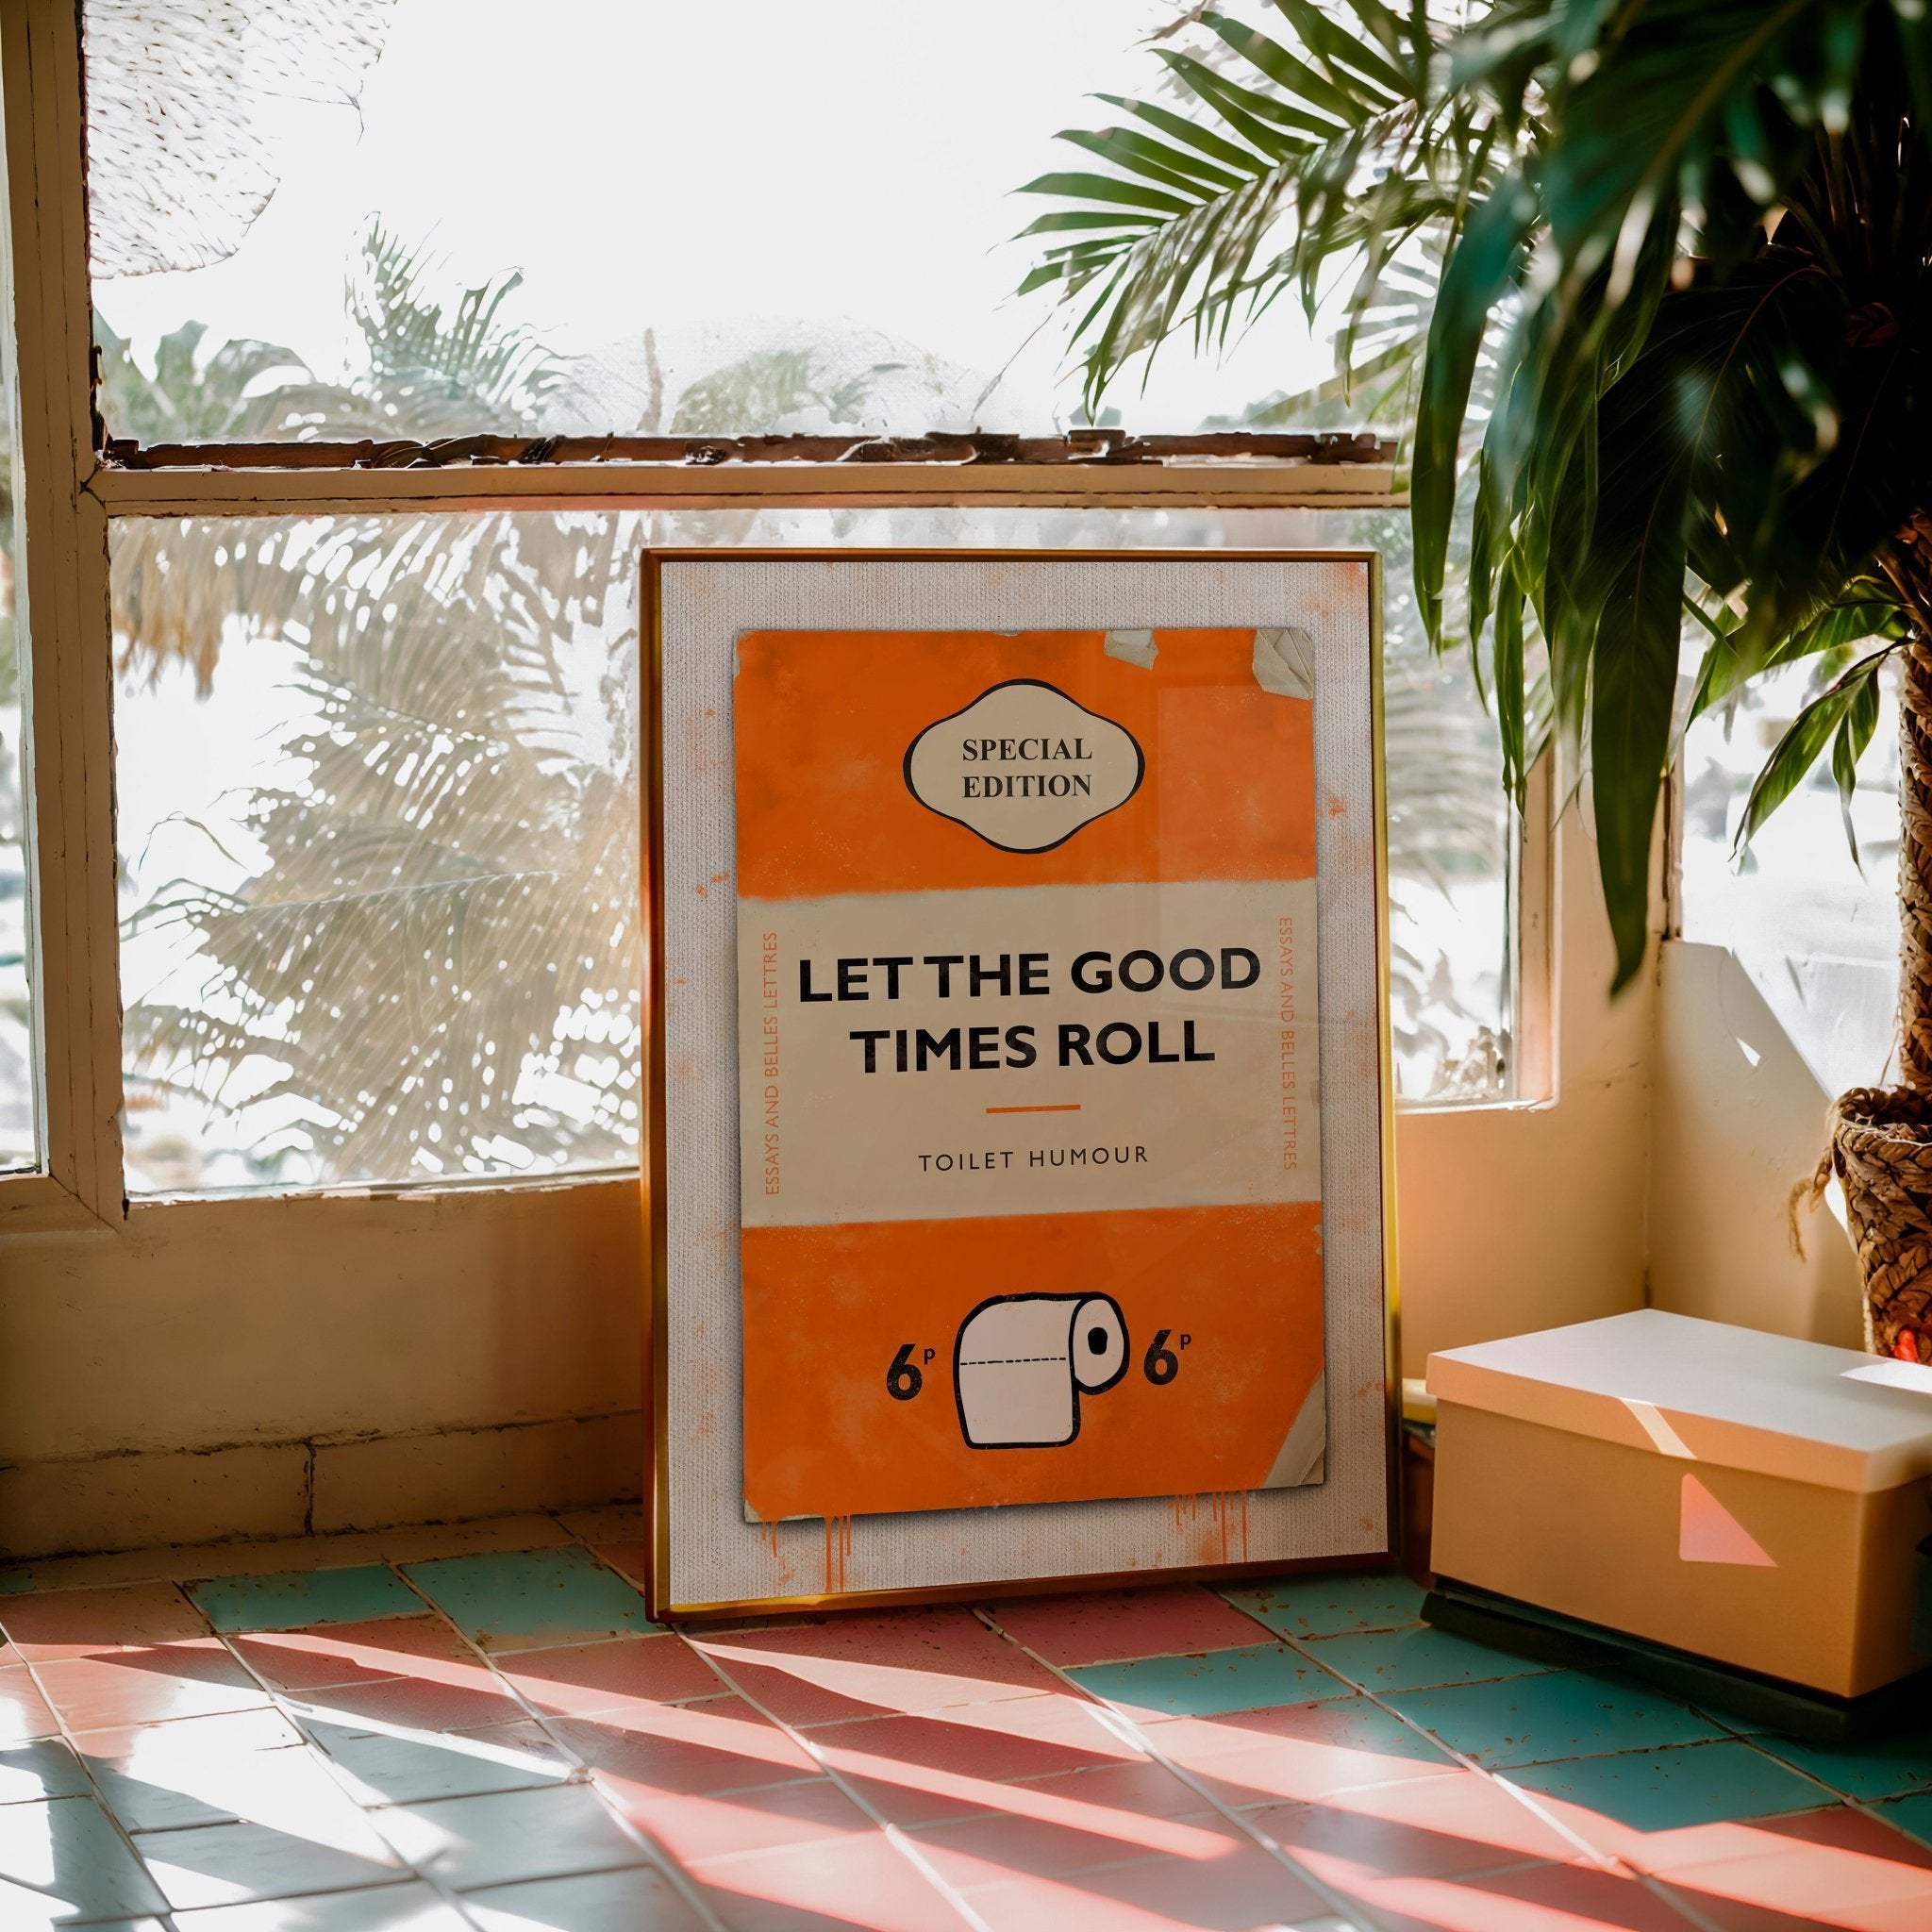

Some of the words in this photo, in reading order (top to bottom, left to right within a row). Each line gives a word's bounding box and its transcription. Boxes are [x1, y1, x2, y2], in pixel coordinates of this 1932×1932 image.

[961, 737, 1092, 761] SPECIAL
[963, 774, 1091, 798] EDITION
[762, 932, 778, 1008] LETTRES
[1278, 917, 1293, 976] ESSAYS
[799, 957, 914, 1003] LET
[923, 953, 1050, 998] THE
[1071, 947, 1261, 994] GOOD
[1280, 981, 1294, 1023] AND
[763, 1016, 778, 1077] BELLES
[849, 1024, 1037, 1074] TIMES
[1058, 1020, 1216, 1067] ROLL
[1281, 1030, 1295, 1090] BELLES
[764, 1085, 779, 1128] AND
[1282, 1096, 1297, 1171] LETTRES
[765, 1133, 780, 1195] ESSAYS
[918, 1151, 1014, 1173] TOILET
[1029, 1144, 1148, 1168] HUMOUR
